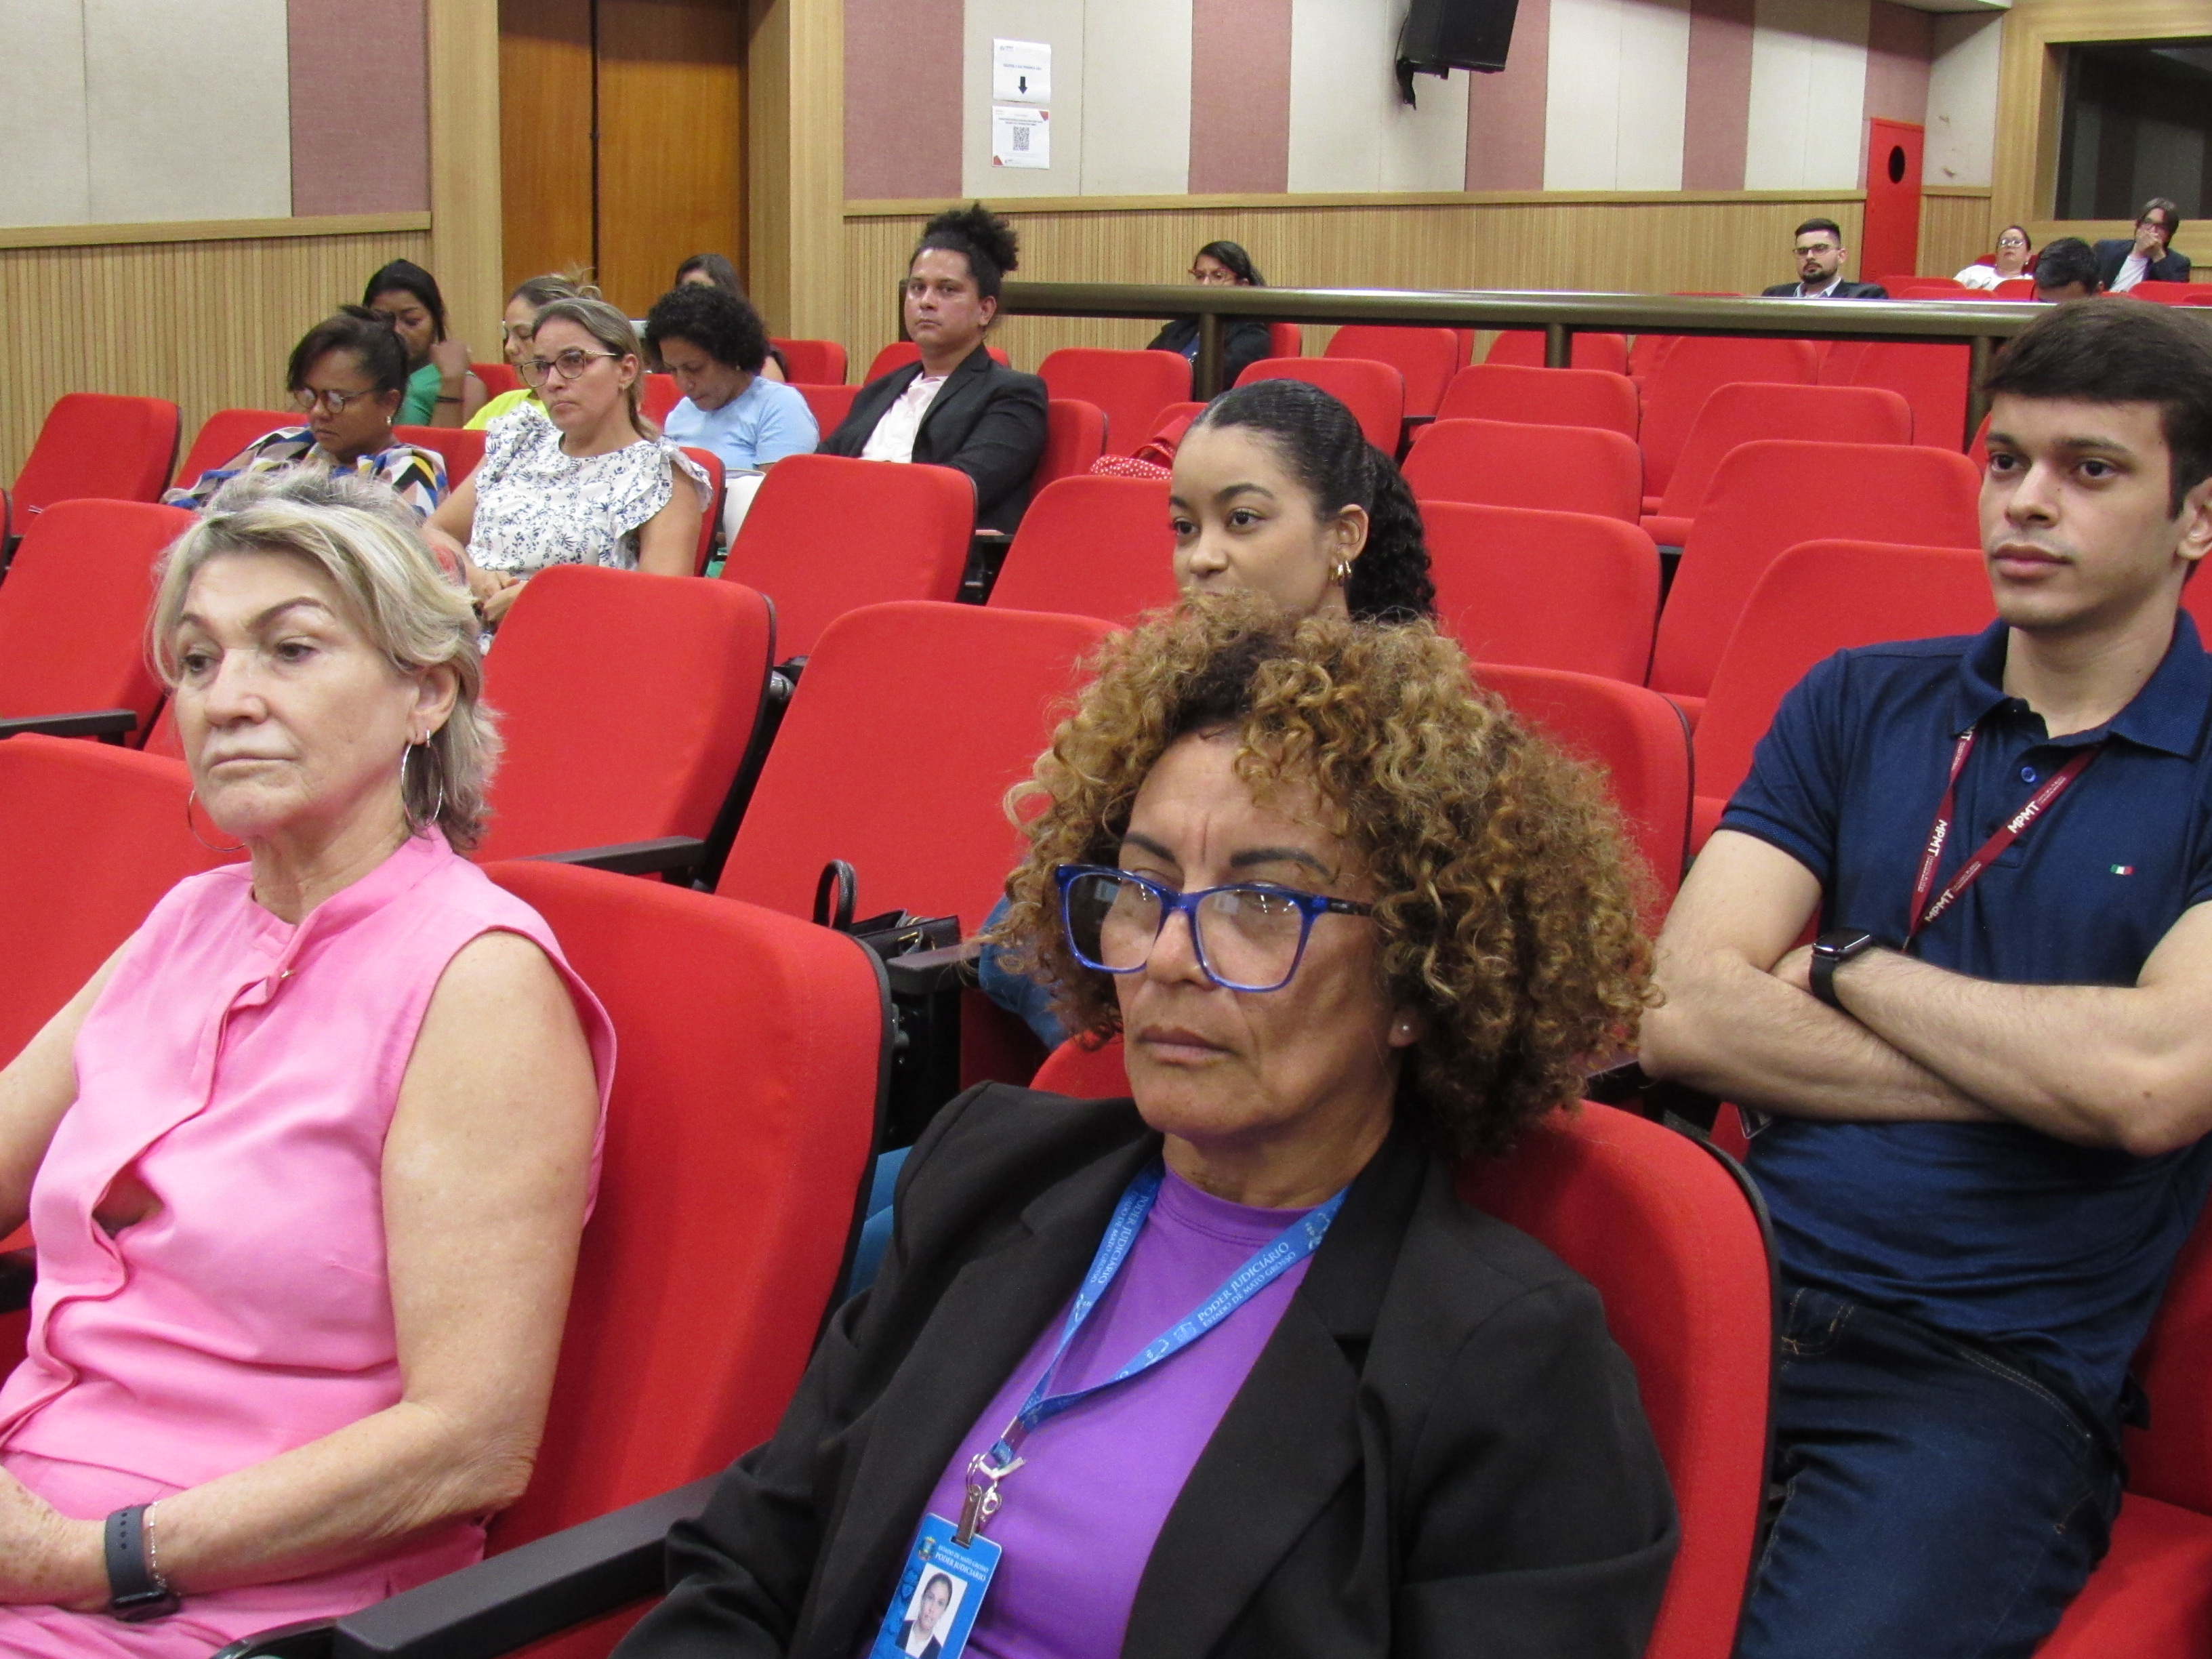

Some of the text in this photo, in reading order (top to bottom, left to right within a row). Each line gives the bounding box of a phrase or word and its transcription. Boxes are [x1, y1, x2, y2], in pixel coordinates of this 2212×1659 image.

[2007, 800, 2040, 834] MPMT
[1927, 819, 1948, 857] MPMT
[1924, 888, 1954, 922] MPMT
[1126, 1195, 1150, 1225] PODER
[1105, 1229, 1118, 1252] MATO
[1197, 1242, 1289, 1322] PODER JUDICIÁRIO
[1202, 1251, 1296, 1328] ESTADO DE MATO GROSSO
[935, 1551, 954, 1566] PODER
